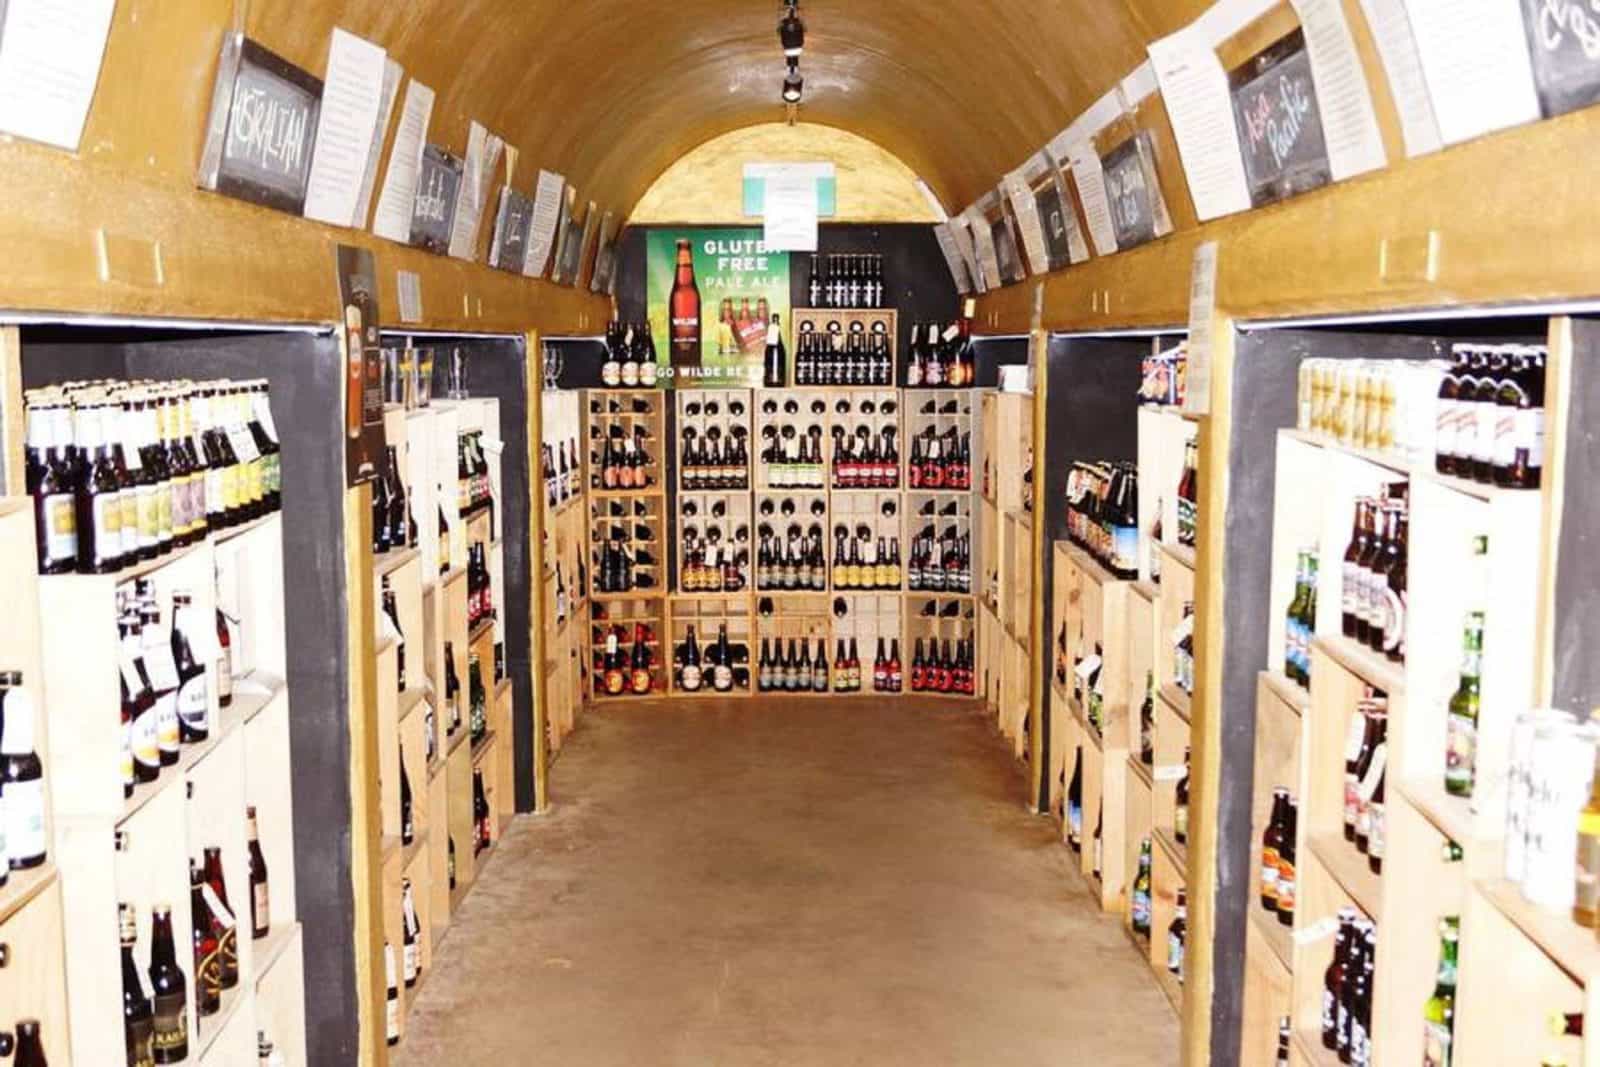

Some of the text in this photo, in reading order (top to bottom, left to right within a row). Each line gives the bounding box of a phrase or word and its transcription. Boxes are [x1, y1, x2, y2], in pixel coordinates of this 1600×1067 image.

[717, 257, 768, 271] FREE
[705, 276, 781, 288] PALE ALE
[657, 367, 675, 377] GO
[680, 367, 721, 377] WILDE
